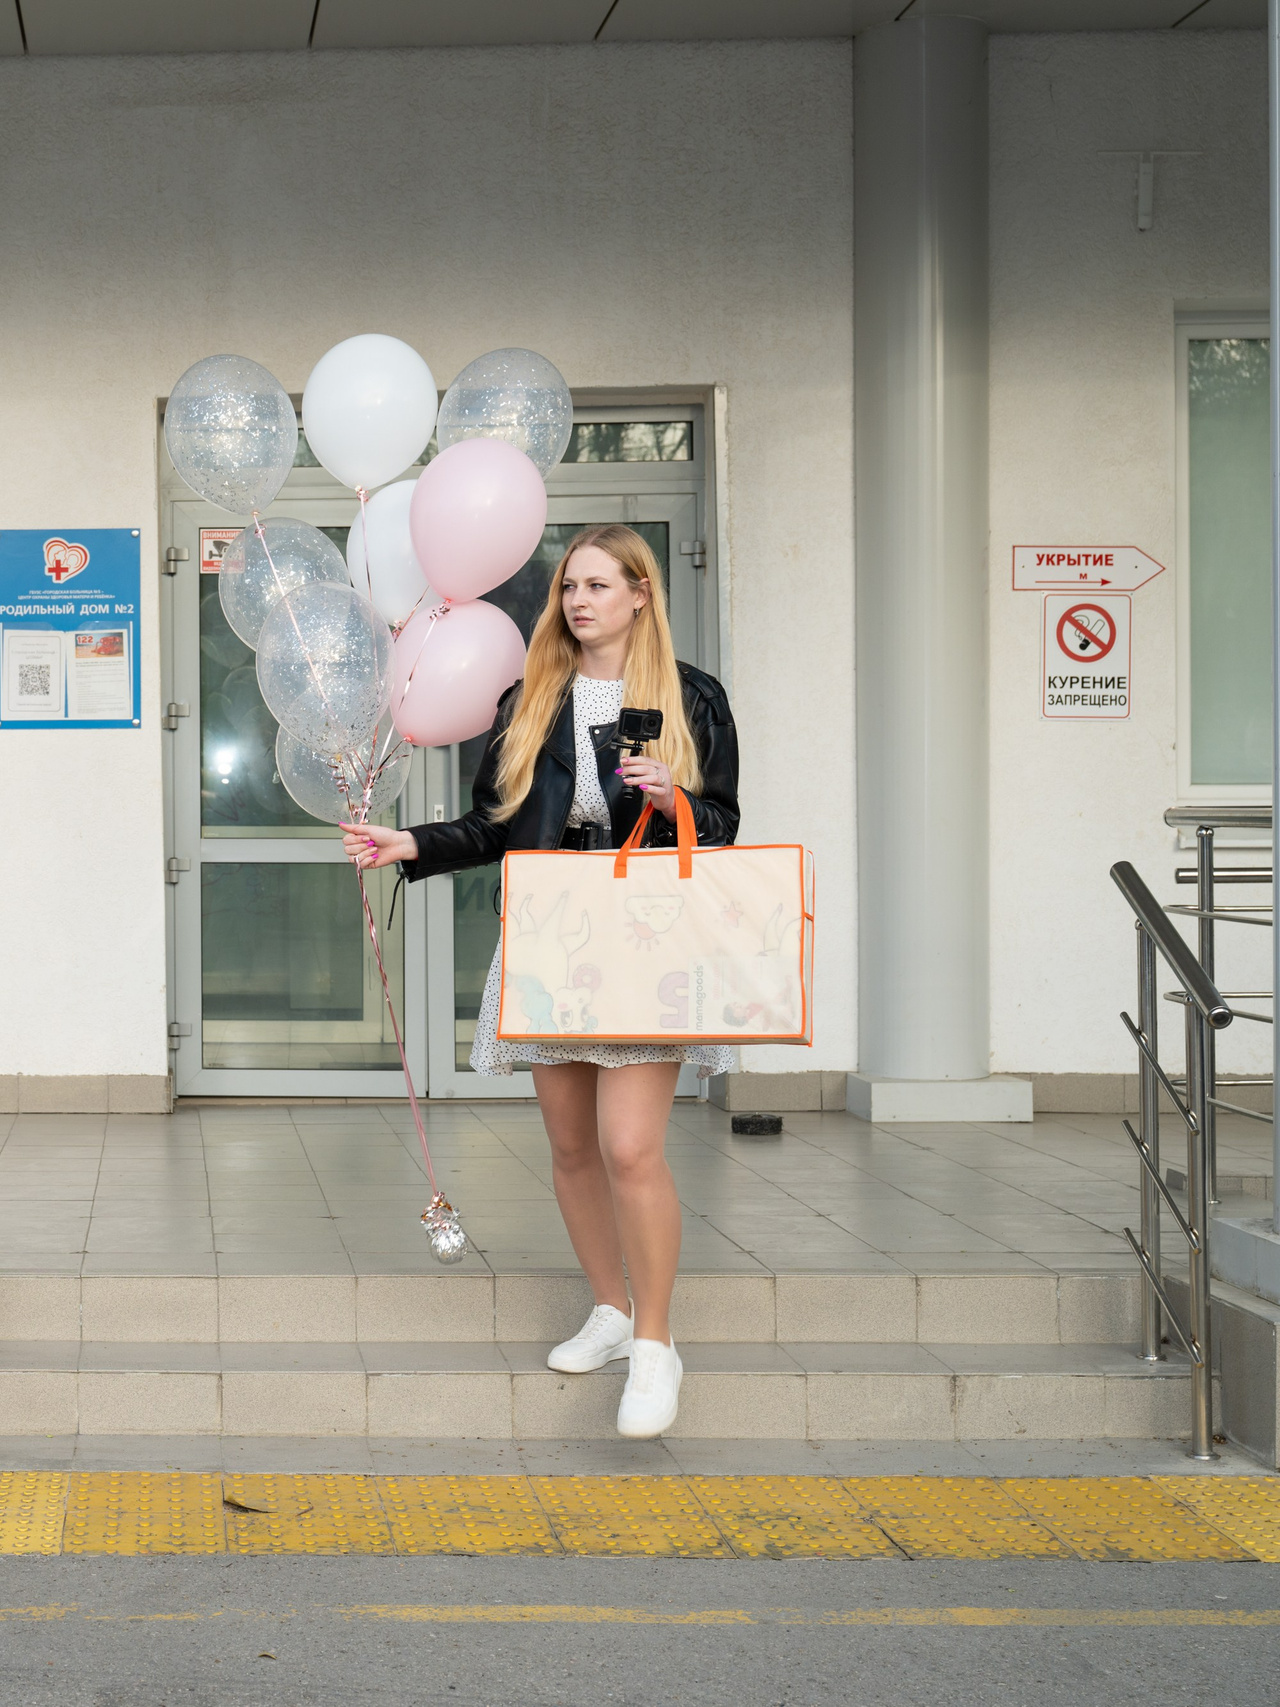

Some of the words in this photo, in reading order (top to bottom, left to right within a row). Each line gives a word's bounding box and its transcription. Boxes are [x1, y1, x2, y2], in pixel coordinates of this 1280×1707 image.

[1036, 553, 1114, 566] УКРЫТИЕ
[0, 602, 75, 617] РОДИЛЬНЫЙ
[80, 604, 110, 616] ДОМ
[114, 603, 135, 614] №2
[76, 635, 94, 644] 122
[1047, 676, 1127, 690] КУРЕНИЕ
[1047, 694, 1127, 708] ЗАПРЕЩЕНО
